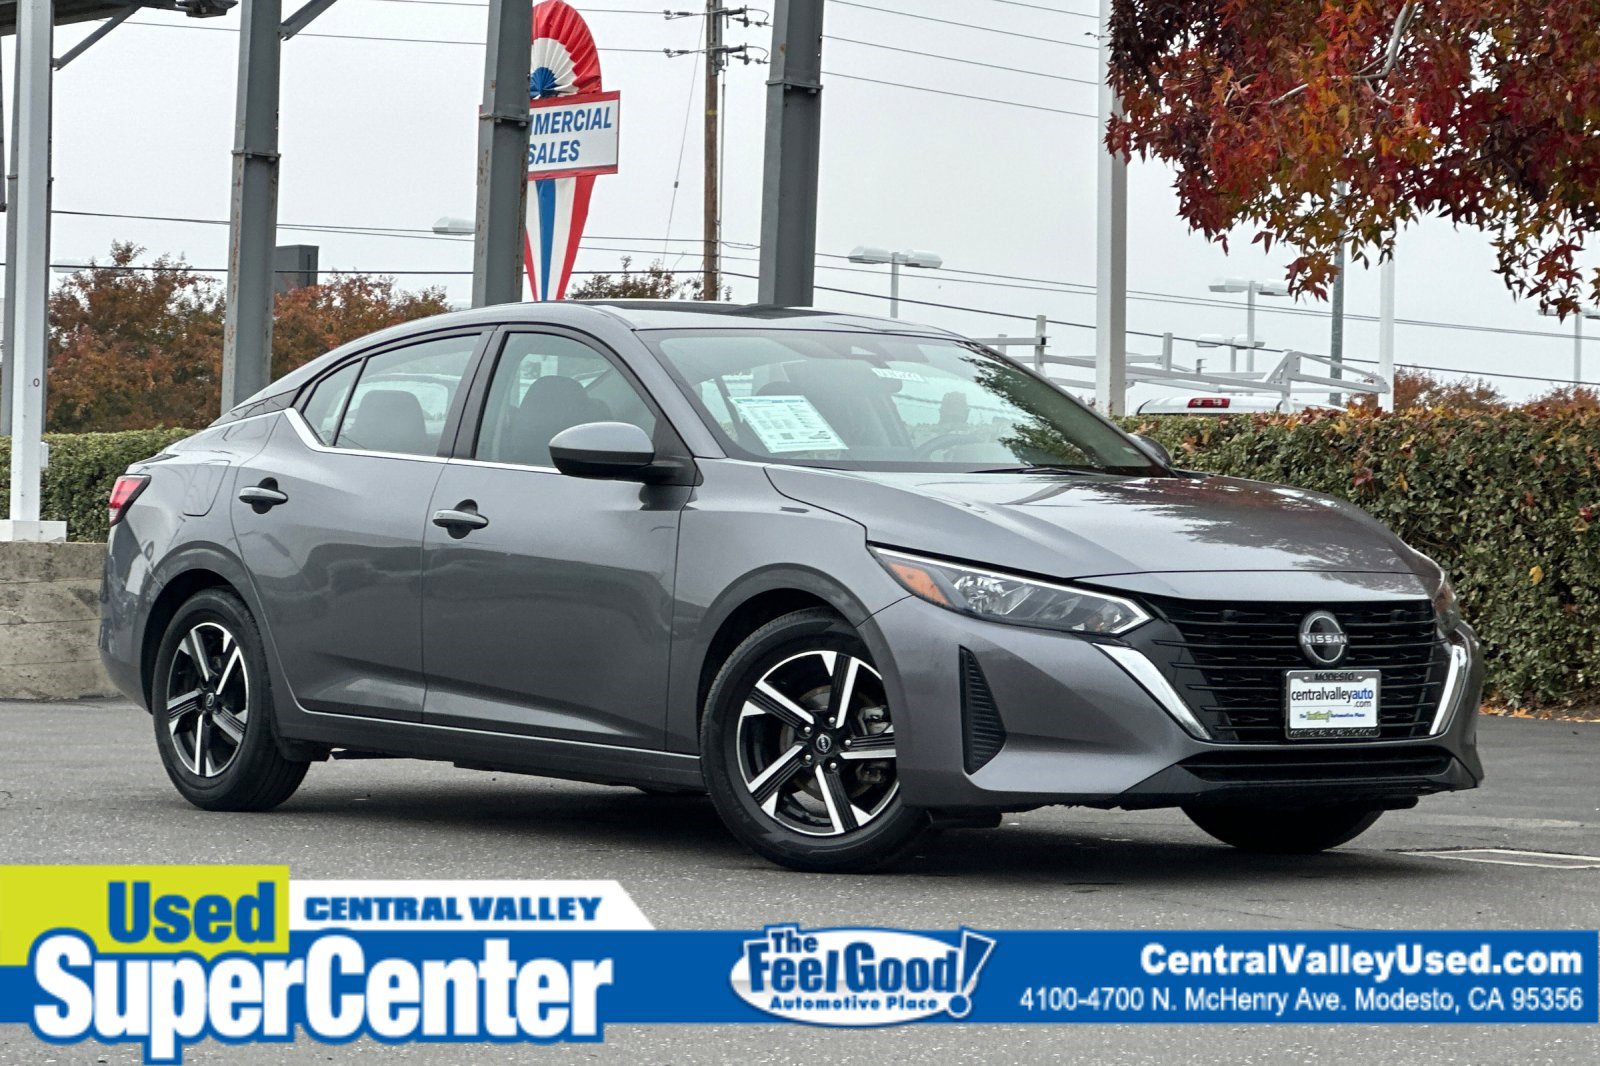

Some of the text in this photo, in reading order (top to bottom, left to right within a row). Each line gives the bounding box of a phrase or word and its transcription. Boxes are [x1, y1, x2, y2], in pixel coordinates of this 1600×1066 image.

[530, 107, 612, 135] MERCIAL
[528, 140, 581, 165] SALES
[1301, 634, 1348, 644] NISSAN
[1314, 672, 1355, 681] MODESTO
